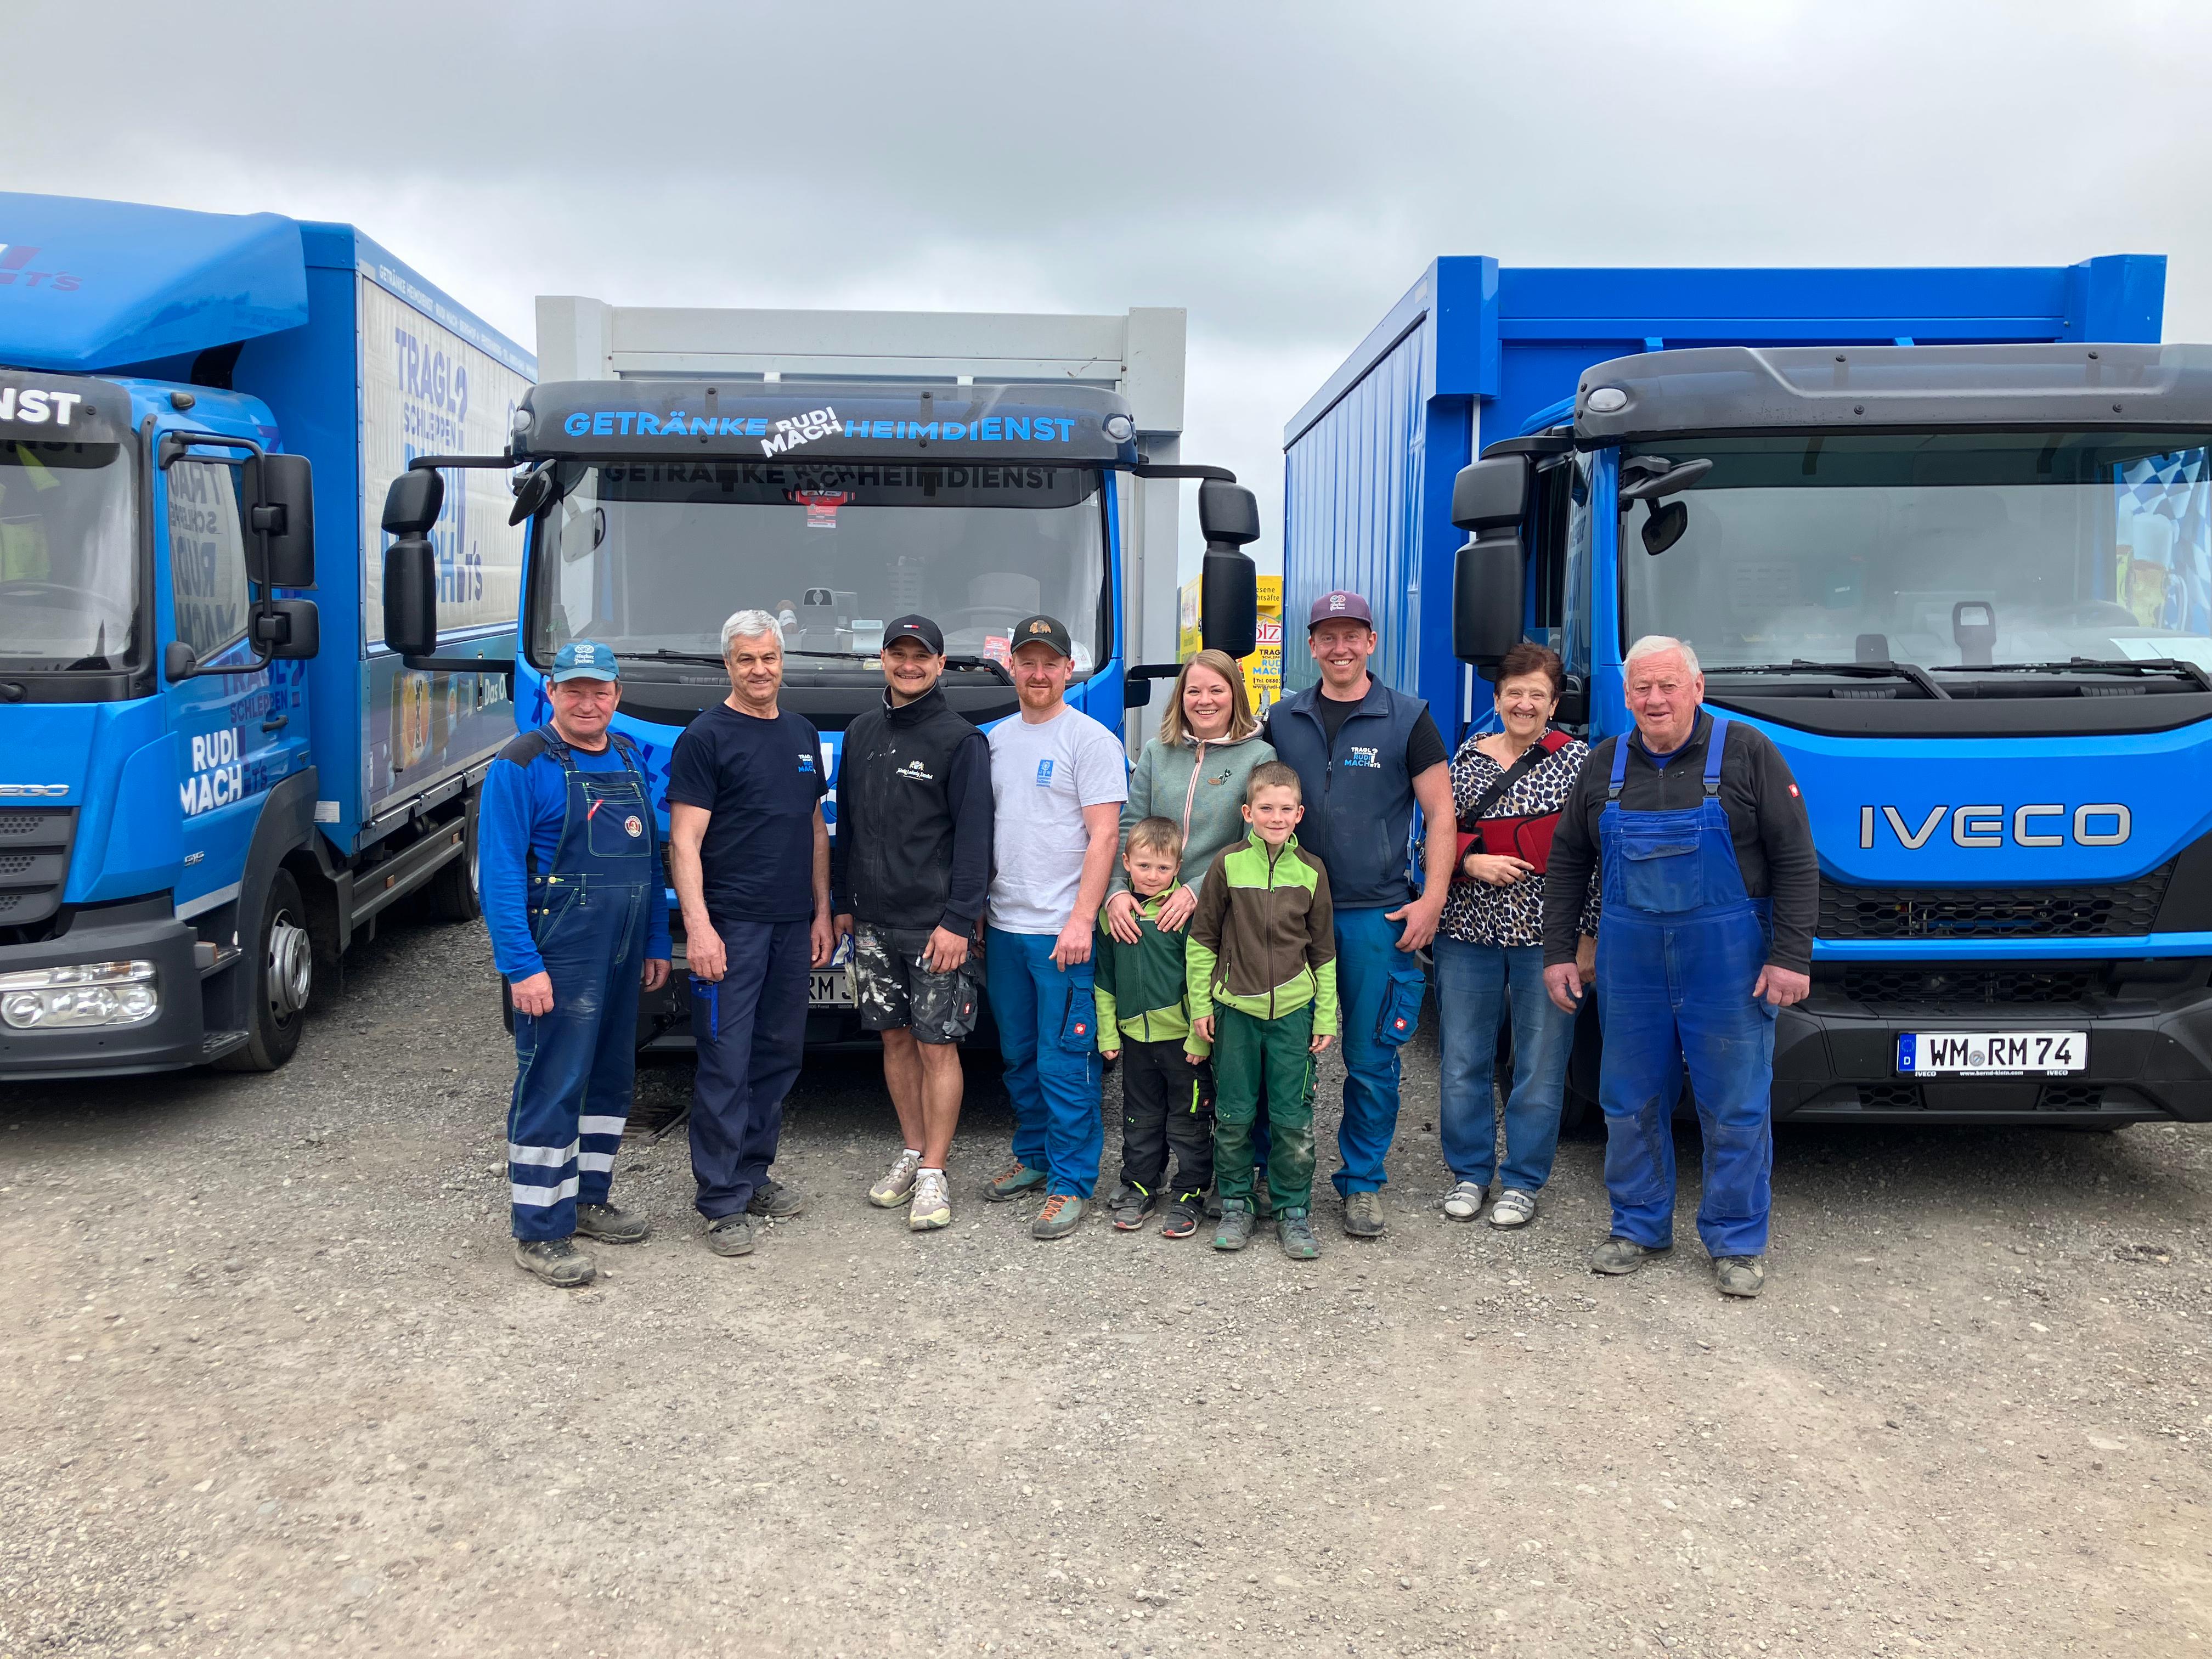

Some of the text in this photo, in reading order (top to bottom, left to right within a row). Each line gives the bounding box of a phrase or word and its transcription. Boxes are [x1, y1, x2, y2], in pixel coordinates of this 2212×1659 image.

[565, 411, 1075, 442] GETRÄNKE HEIMDIENST
[775, 407, 837, 432] RUDI
[760, 420, 843, 458] MACH
[192, 727, 238, 772] RUDI
[180, 764, 242, 816] MACH
[1859, 804, 2132, 850] IVECO
[1904, 1056, 1911, 1065] D
[1930, 1037, 2072, 1066] WM RM 74
